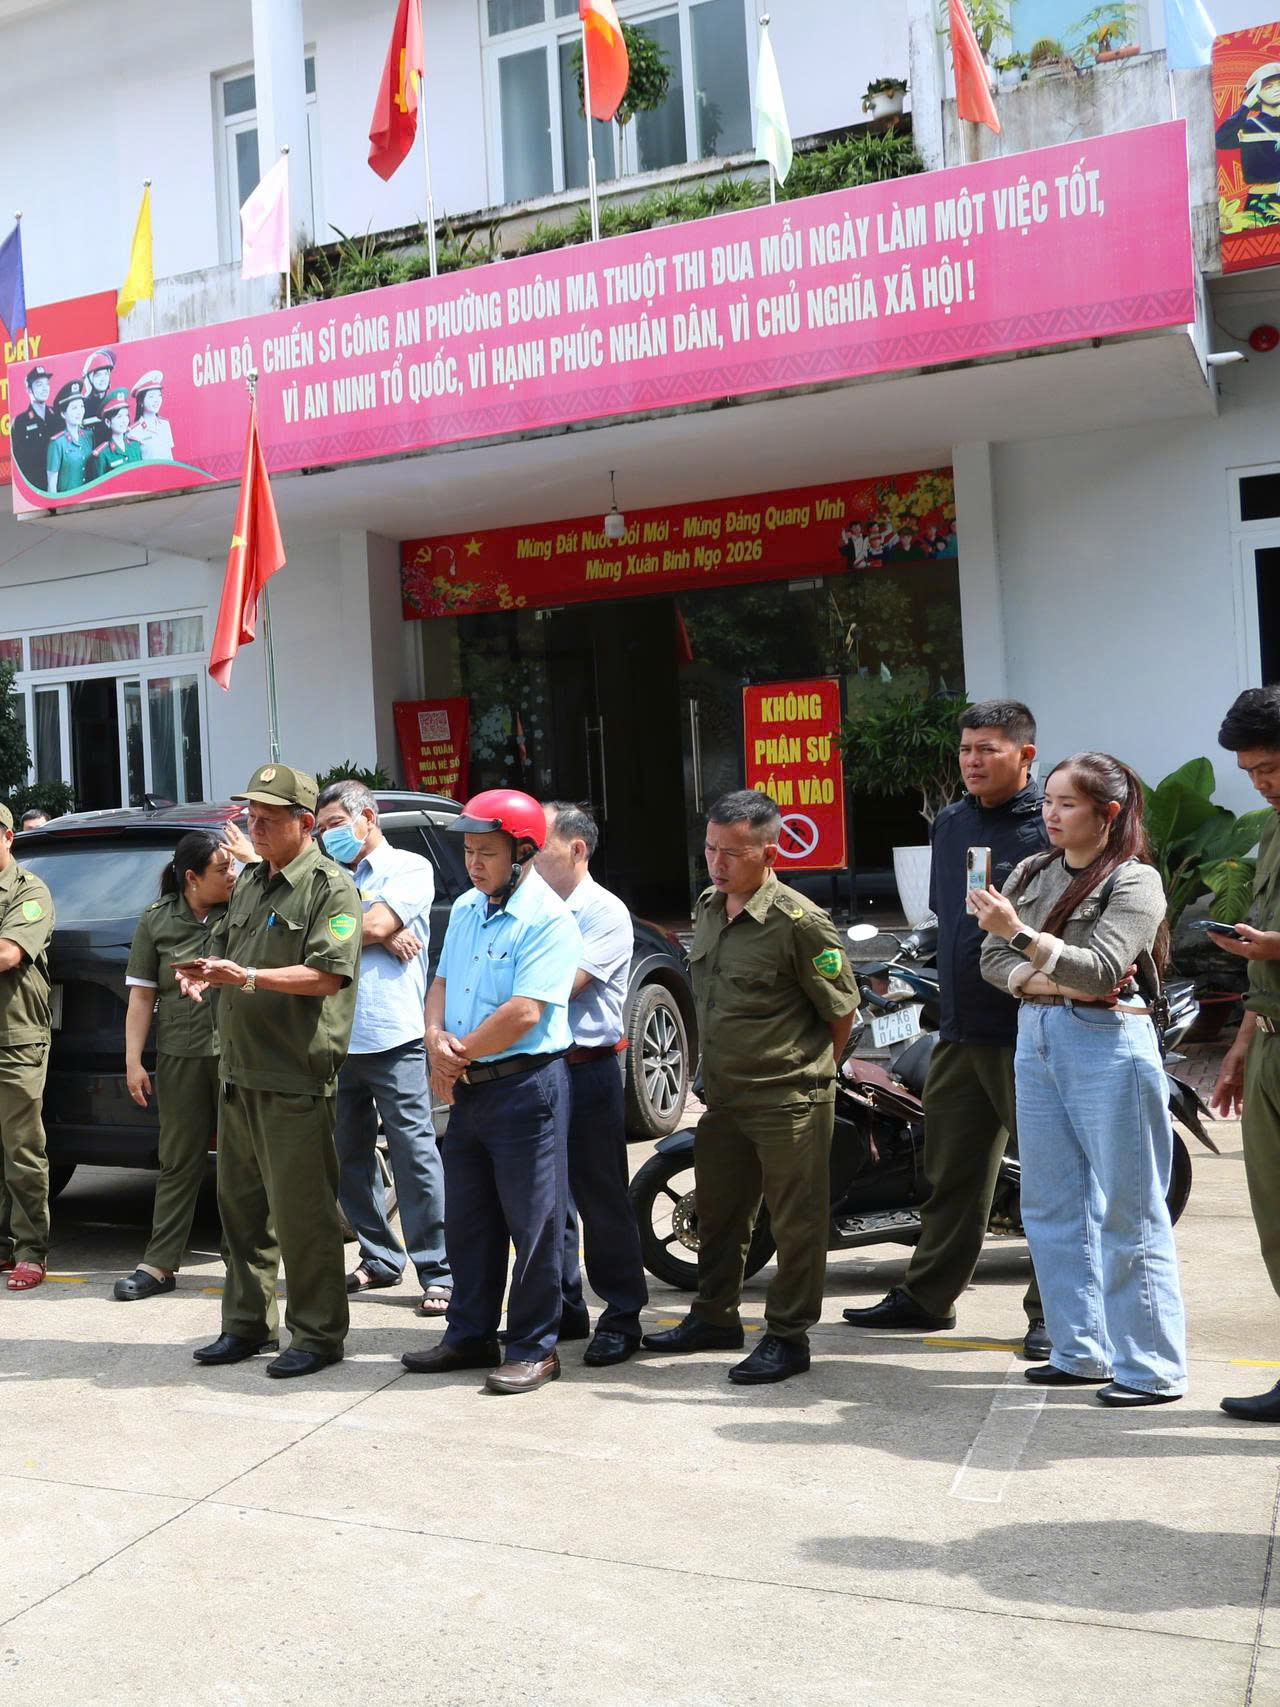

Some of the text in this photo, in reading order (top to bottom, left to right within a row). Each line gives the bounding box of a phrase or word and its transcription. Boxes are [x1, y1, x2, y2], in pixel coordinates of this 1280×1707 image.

[193, 344, 227, 388] CÁN
[263, 321, 313, 373] CHIẾN
[319, 318, 336, 363] SĨ
[341, 313, 390, 358] CÔNG
[394, 308, 420, 347] AN
[425, 288, 502, 341] PHƯỜNG
[507, 274, 561, 325] BUÔN
[566, 271, 599, 313] MA
[604, 252, 667, 307] THUỘT
[672, 250, 705, 292] THI
[711, 240, 754, 286] ĐUA
[760, 217, 803, 276] MỖI
[809, 211, 870, 266] NGÀY
[877, 202, 927, 254] LÀM
[934, 187, 986, 247] MỘT
[993, 175, 1048, 236] VIỆC
[1055, 157, 1105, 218] TỐT,
[282, 380, 300, 424] VÌ
[304, 382, 328, 421] AN
[332, 372, 376, 414] NINH
[381, 352, 404, 406] TỔ
[408, 345, 464, 406] QUỐC,
[468, 343, 487, 389] VÌ
[492, 339, 544, 391] HẠNH
[550, 323, 604, 374] PHÚC
[609, 312, 667, 364] NHÂN
[673, 303, 724, 354] DÂN,
[729, 293, 750, 343] VÌ
[756, 280, 801, 338] CHỦ
[807, 272, 878, 329] NGHĨA
[883, 264, 916, 316] XÃ
[556, 530, 578, 554] Đất
[643, 520, 669, 543] Mới
[725, 509, 761, 534] Đảng
[765, 505, 810, 529] Quang
[626, 553, 659, 576] Xuân
[694, 546, 721, 571] Ngọ
[726, 539, 762, 563] 2026
[761, 691, 822, 723] KHÔNG
[754, 731, 833, 769] PHẬN SỰ
[798, 775, 834, 805] VÀO
